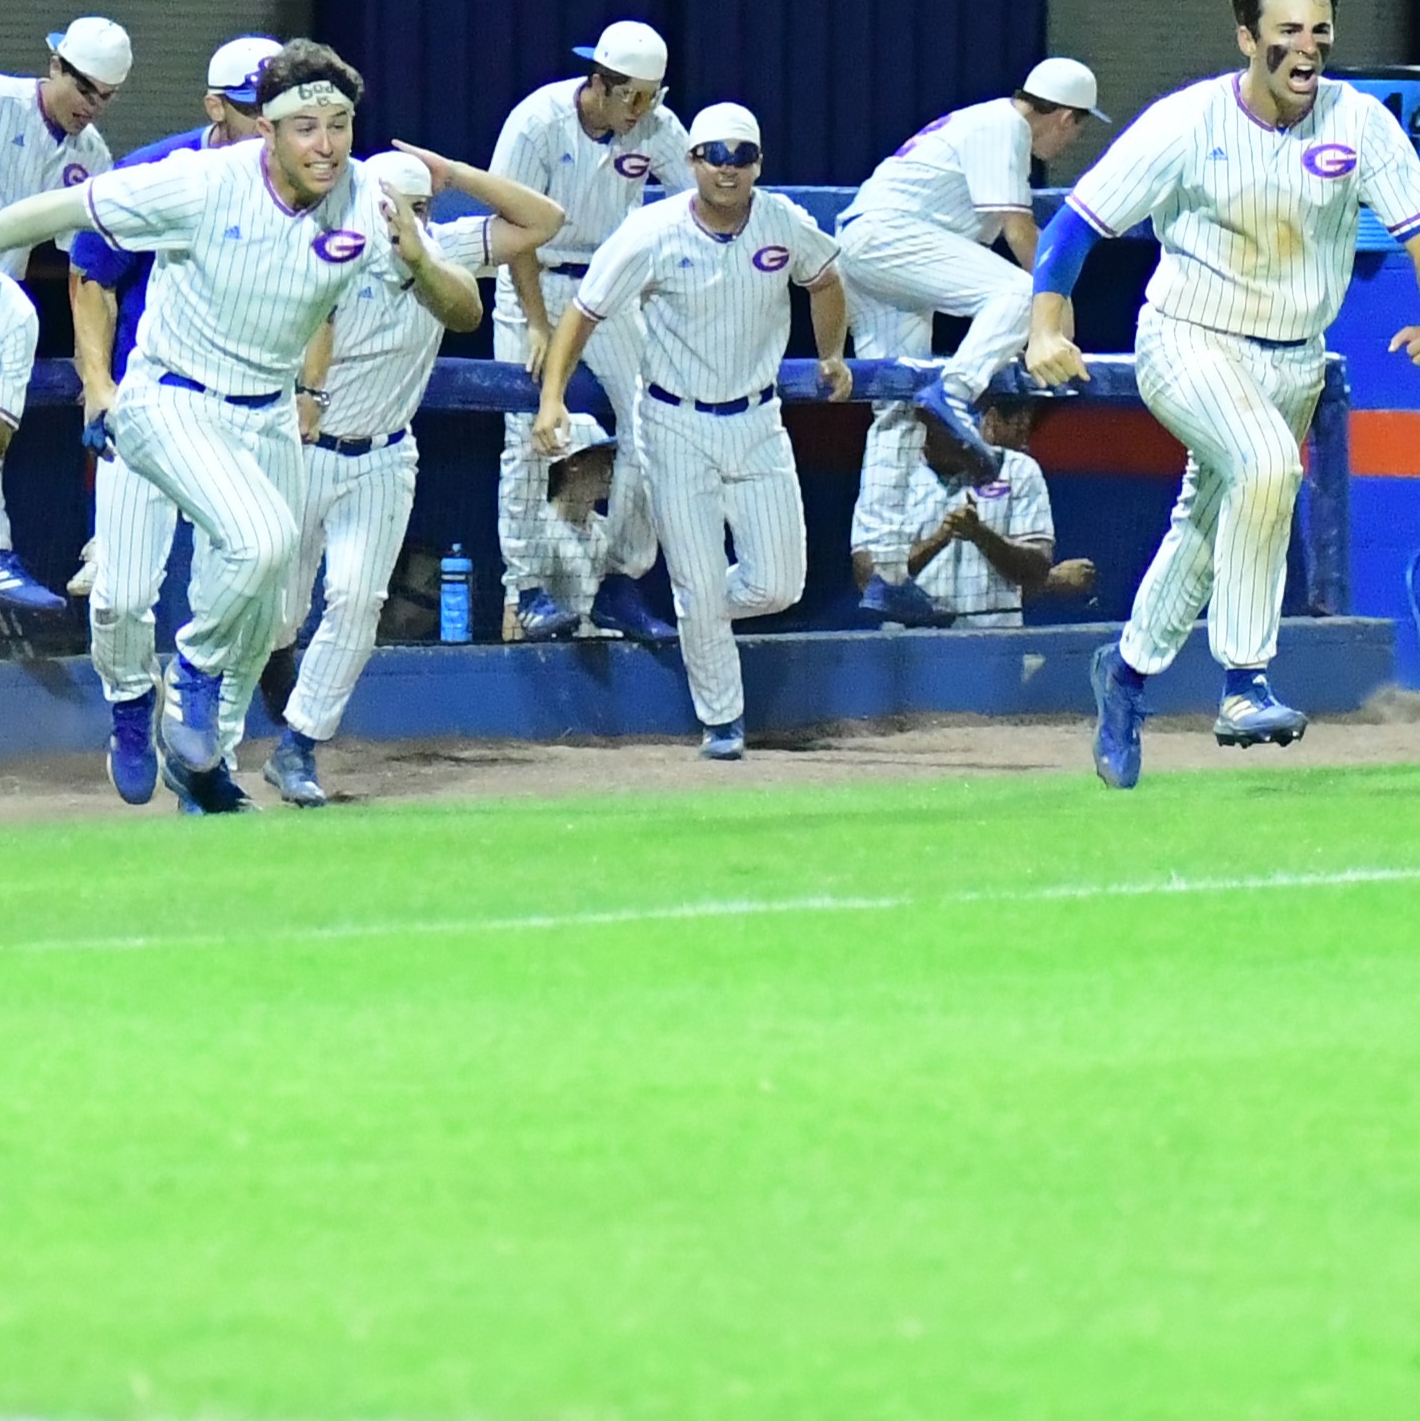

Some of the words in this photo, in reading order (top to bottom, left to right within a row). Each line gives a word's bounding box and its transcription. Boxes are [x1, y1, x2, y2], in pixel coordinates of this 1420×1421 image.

[614, 154, 651, 178] G
[1302, 143, 1357, 179] G
[311, 229, 366, 263] G
[752, 246, 790, 272] G
